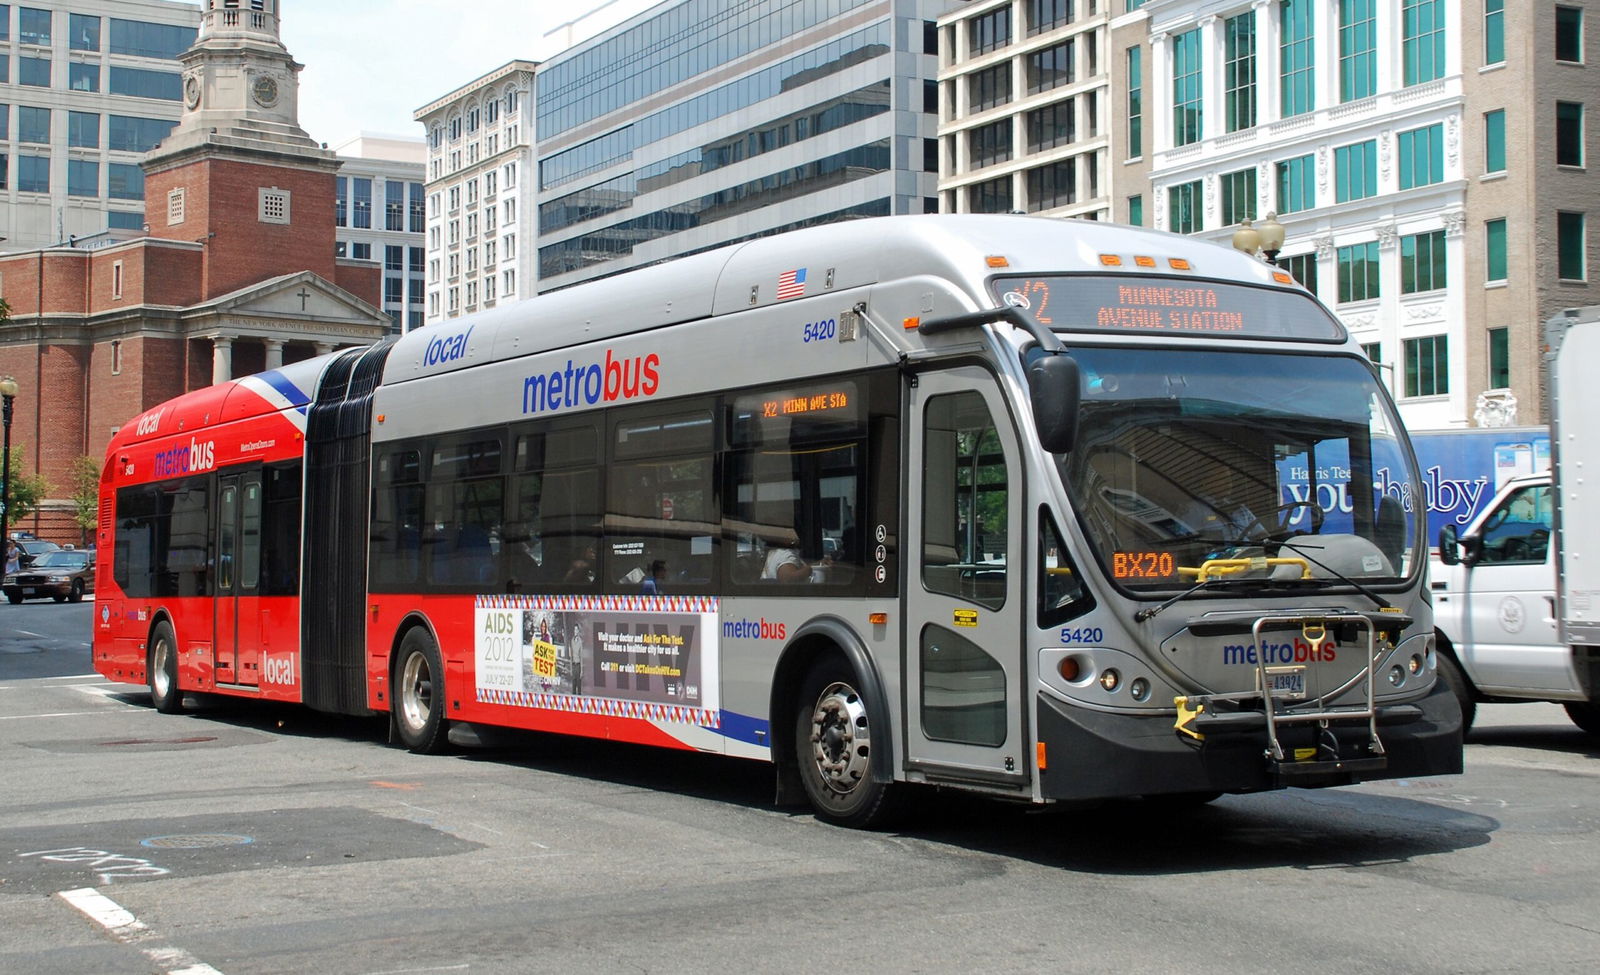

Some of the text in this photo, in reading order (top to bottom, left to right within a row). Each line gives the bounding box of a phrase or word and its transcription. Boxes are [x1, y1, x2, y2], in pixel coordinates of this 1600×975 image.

[1118, 285, 1218, 308] MINNESOTA
[1097, 306, 1243, 330] AVENUE STATION
[803, 318, 835, 343] 5420
[423, 325, 474, 367] local
[522, 349, 660, 414] metrobus
[763, 391, 848, 418] X2 MINN AVE STA
[136, 406, 165, 436] local
[154, 437, 214, 477] metrobus
[1290, 466, 1352, 480] Haris Tee
[1113, 552, 1174, 578] BX20
[485, 612, 514, 635] AIDS
[723, 617, 786, 640] metrobus
[1061, 628, 1103, 643] 5420
[485, 636, 514, 662] 2012
[598, 631, 608, 641] Visit
[608, 634, 619, 643] your
[620, 632, 634, 643] doctor
[635, 633, 643, 643] and
[643, 633, 652, 643] Ask
[653, 634, 661, 644] For
[661, 635, 671, 645] The
[608, 642, 622, 652] makes
[626, 643, 647, 654] healthier
[534, 644, 548, 659] ASK
[1223, 637, 1336, 665] metrobus
[263, 650, 295, 685] local
[534, 657, 554, 676] TEST
[485, 673, 498, 685] JULY
